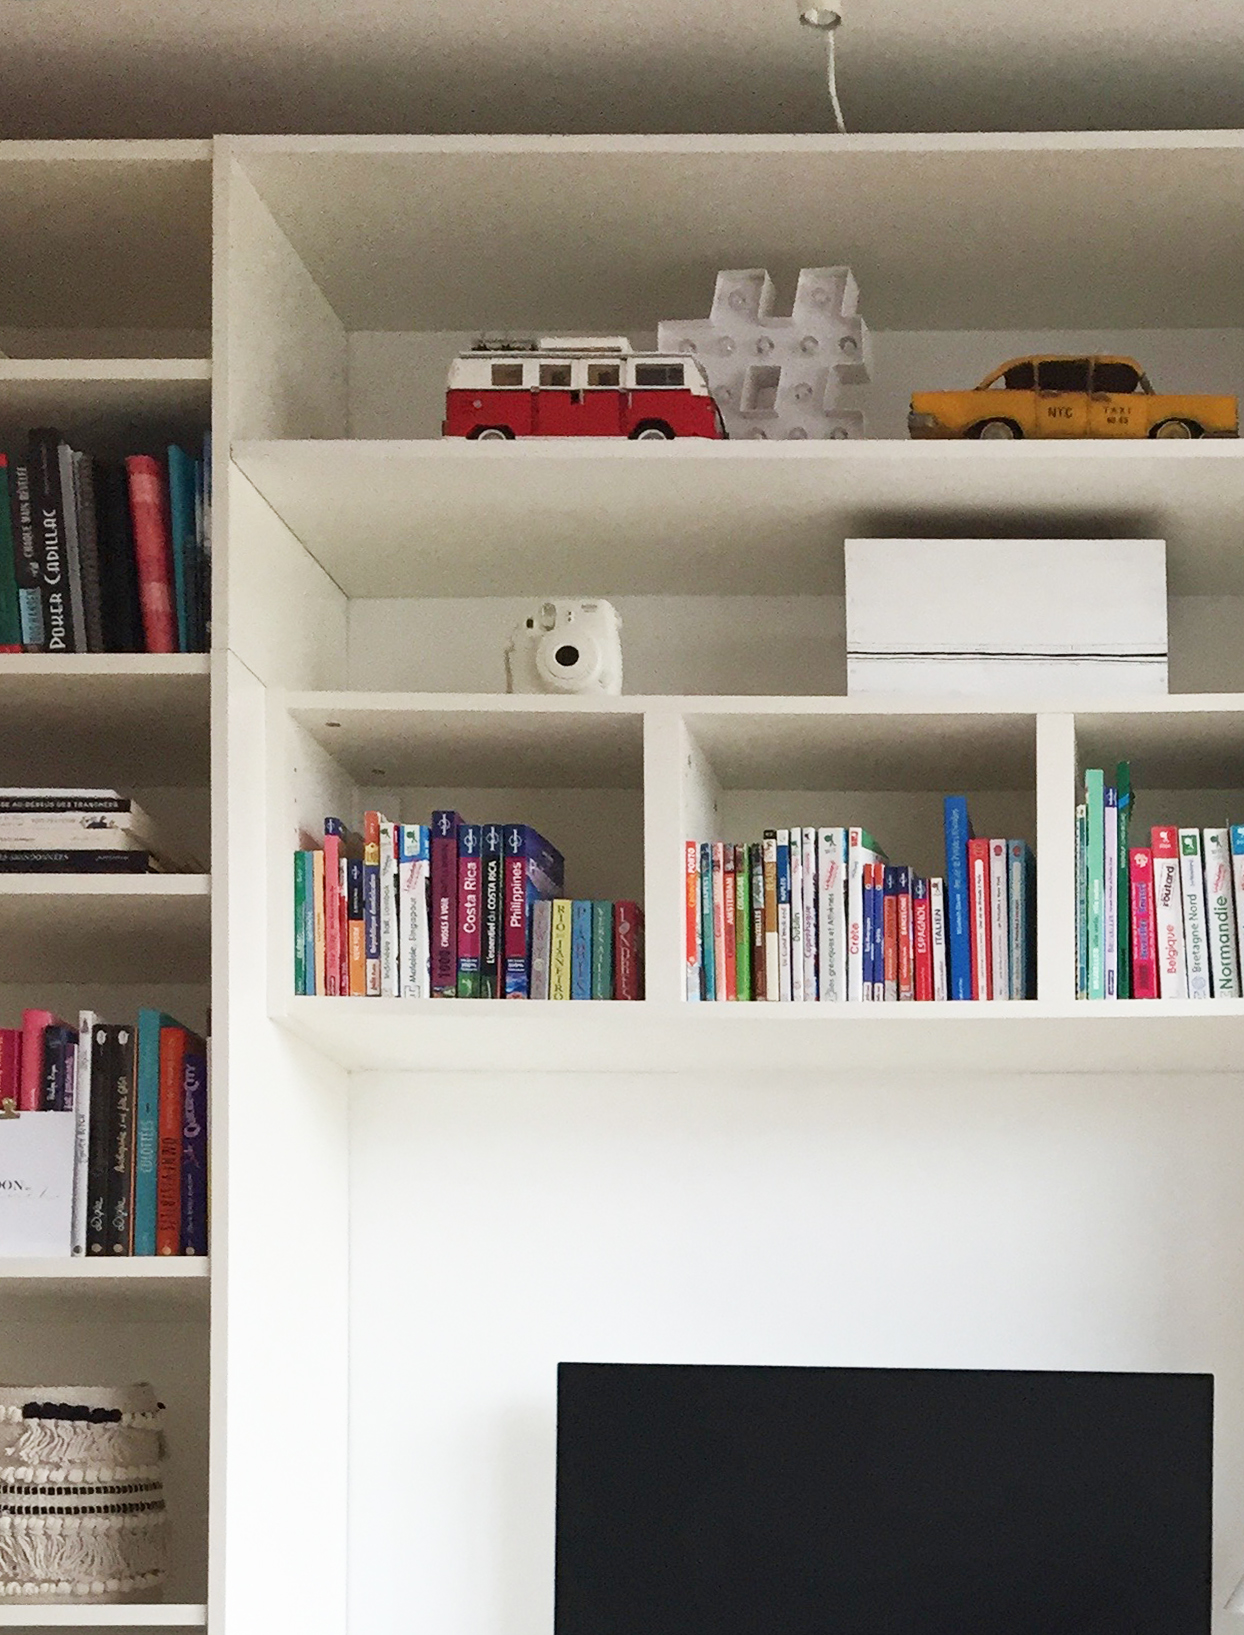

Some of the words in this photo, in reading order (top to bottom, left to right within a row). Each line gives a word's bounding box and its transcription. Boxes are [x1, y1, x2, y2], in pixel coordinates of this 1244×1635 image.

[1047, 407, 1073, 419] NYC
[1103, 406, 1131, 414] TAXI
[42, 509, 61, 585] CADILLAC
[49, 592, 66, 650] POKER
[462, 861, 477, 892] Rica
[487, 860, 496, 881] RICA
[687, 847, 697, 874] PORTO
[440, 896, 449, 914] VOIR
[487, 882, 497, 910] COSTA
[509, 861, 524, 928] Philippines
[725, 877, 735, 925] AMSTERDAM
[1160, 866, 1175, 908] routard
[408, 897, 421, 942] Singapour
[463, 893, 477, 935] Costa
[825, 893, 836, 926] Athènes
[934, 908, 942, 946] ITALIEN
[1187, 894, 1199, 921] Nord
[440, 921, 449, 948] CHOSES
[486, 922, 496, 965] L'essentiel
[849, 922, 860, 955] Crète
[915, 904, 927, 954] ESPAGNOL
[1189, 923, 1202, 973] Bretagne
[1213, 895, 1233, 990] Normandie
[1165, 925, 1179, 974] Belgique
